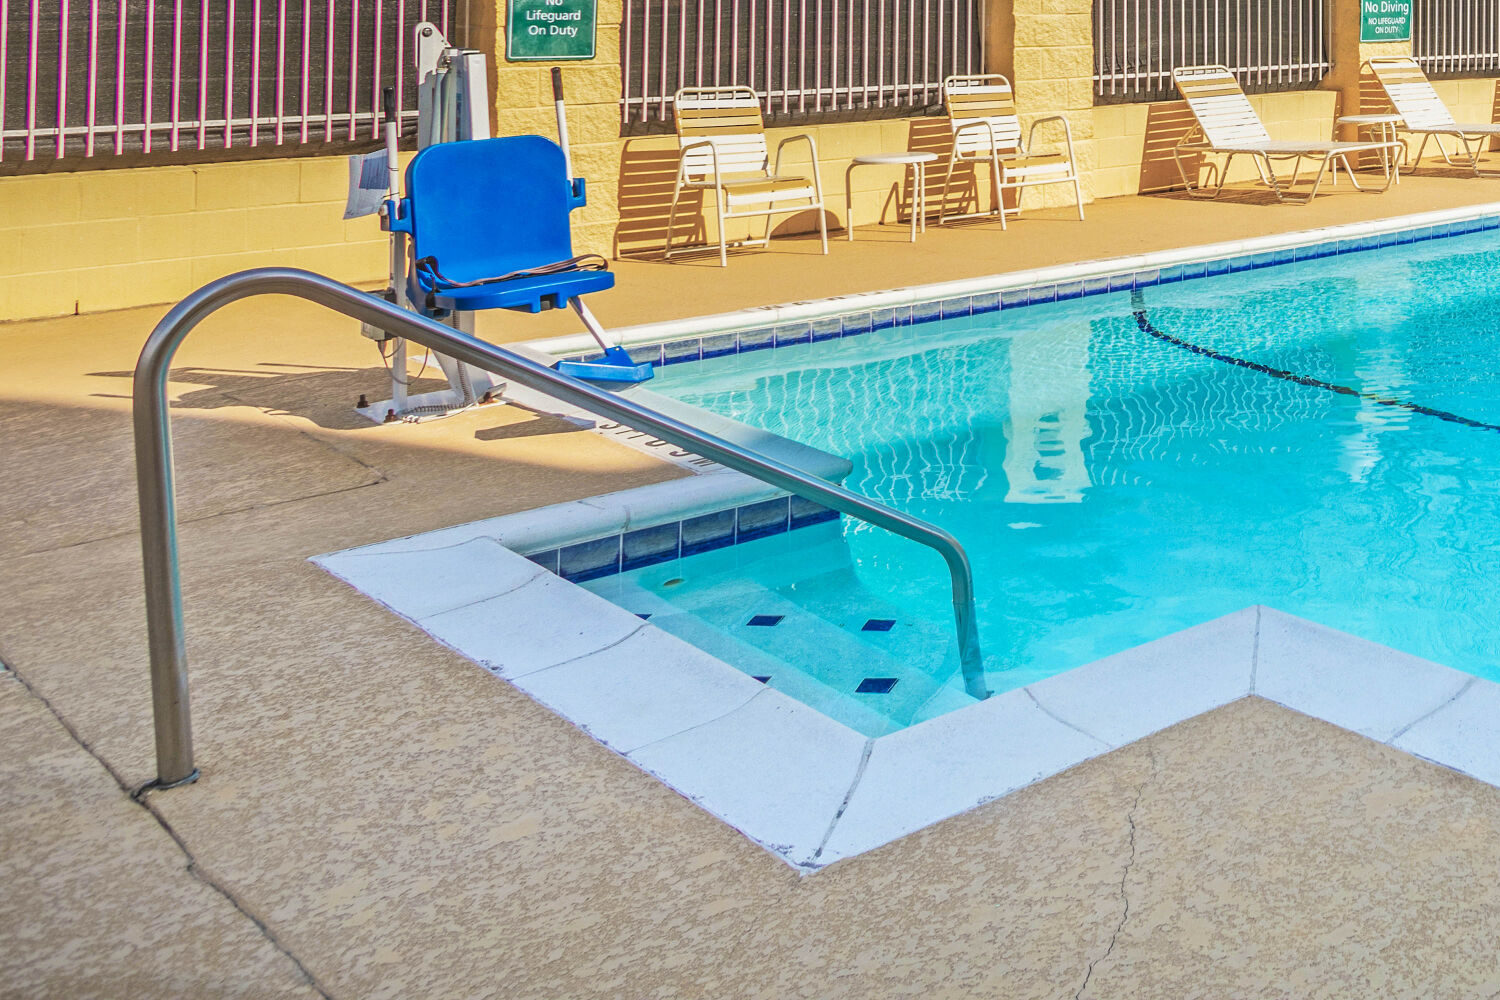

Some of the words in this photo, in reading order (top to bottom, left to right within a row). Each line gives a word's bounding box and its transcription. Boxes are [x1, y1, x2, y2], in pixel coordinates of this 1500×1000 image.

[1365, 1, 1378, 13] No
[1381, 1, 1409, 15] Diving
[526, 10, 581, 23] Lifeguard
[1368, 17, 1377, 25] NO
[528, 25, 546, 35] On
[549, 25, 578, 37] Duty
[1375, 26, 1384, 34] ON
